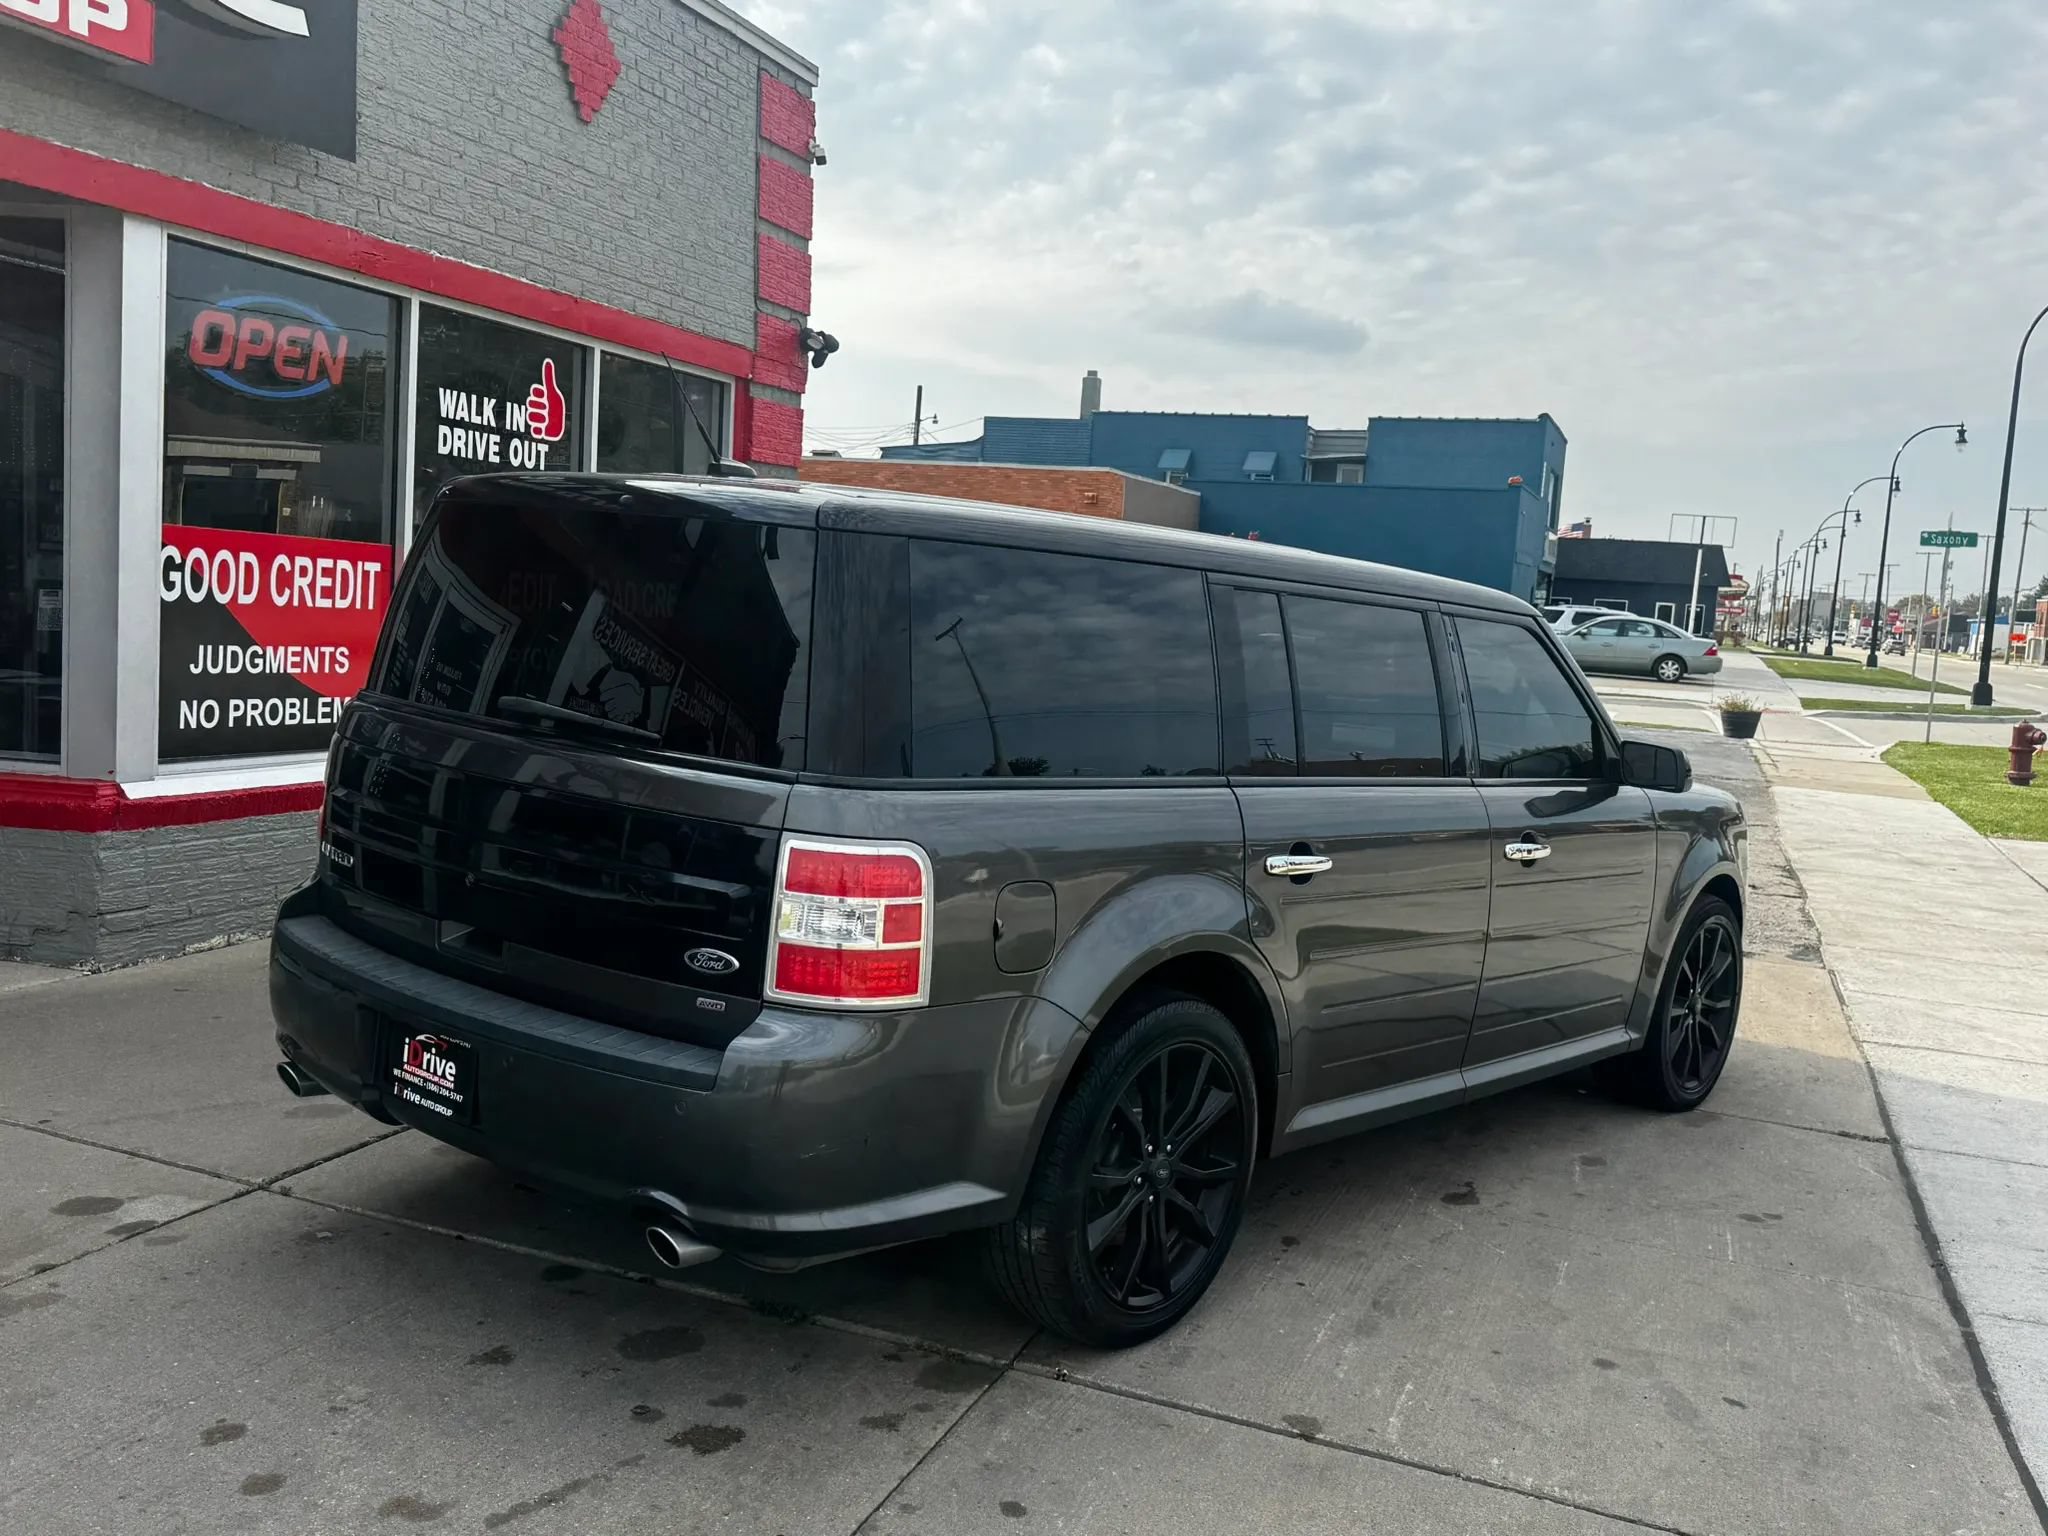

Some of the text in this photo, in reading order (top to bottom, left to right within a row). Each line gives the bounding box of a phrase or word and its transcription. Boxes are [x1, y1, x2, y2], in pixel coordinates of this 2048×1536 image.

[188, 310, 349, 385] OPEN
[438, 387, 526, 433] WALK IN
[437, 424, 549, 471] DRIVE OUT
[1930, 534, 1968, 546] Saxony
[159, 545, 260, 605] GOOD
[269, 554, 382, 610] CREDIT
[189, 644, 350, 675] JUDGMENTS
[179, 698, 220, 729] NO
[694, 952, 726, 969] Ford
[402, 1037, 456, 1081] iDrive
